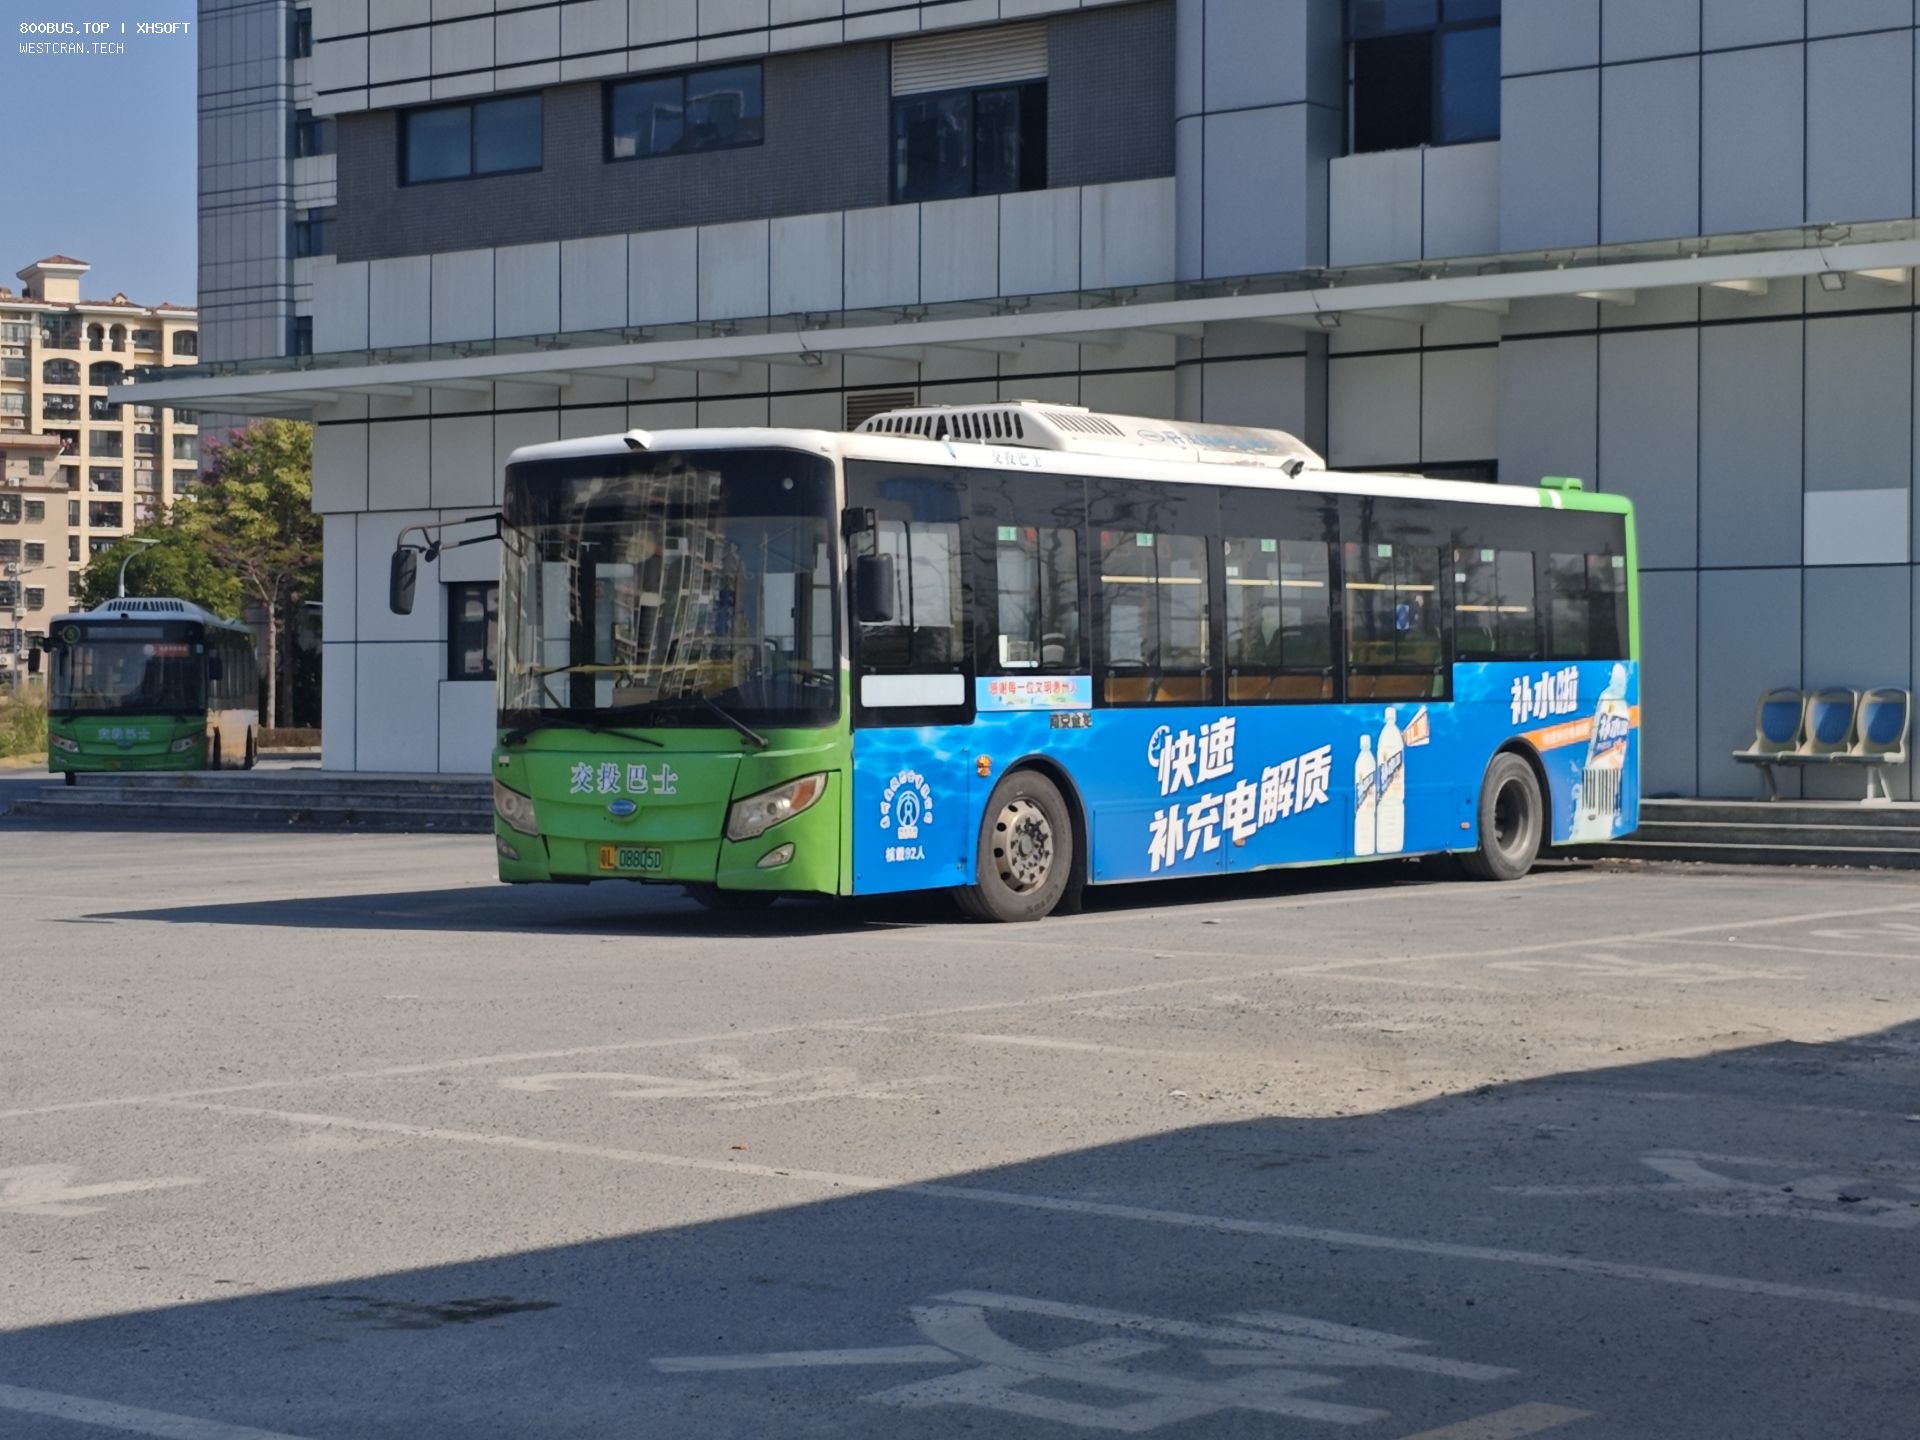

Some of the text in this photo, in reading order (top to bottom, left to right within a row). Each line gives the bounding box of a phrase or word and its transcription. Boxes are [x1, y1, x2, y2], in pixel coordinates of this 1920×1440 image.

[1510, 665, 1580, 726] 补水啦
[569, 761, 679, 796] 交投巴士
[1147, 715, 1237, 797] 快速
[1147, 743, 1333, 873] 补充电解质
